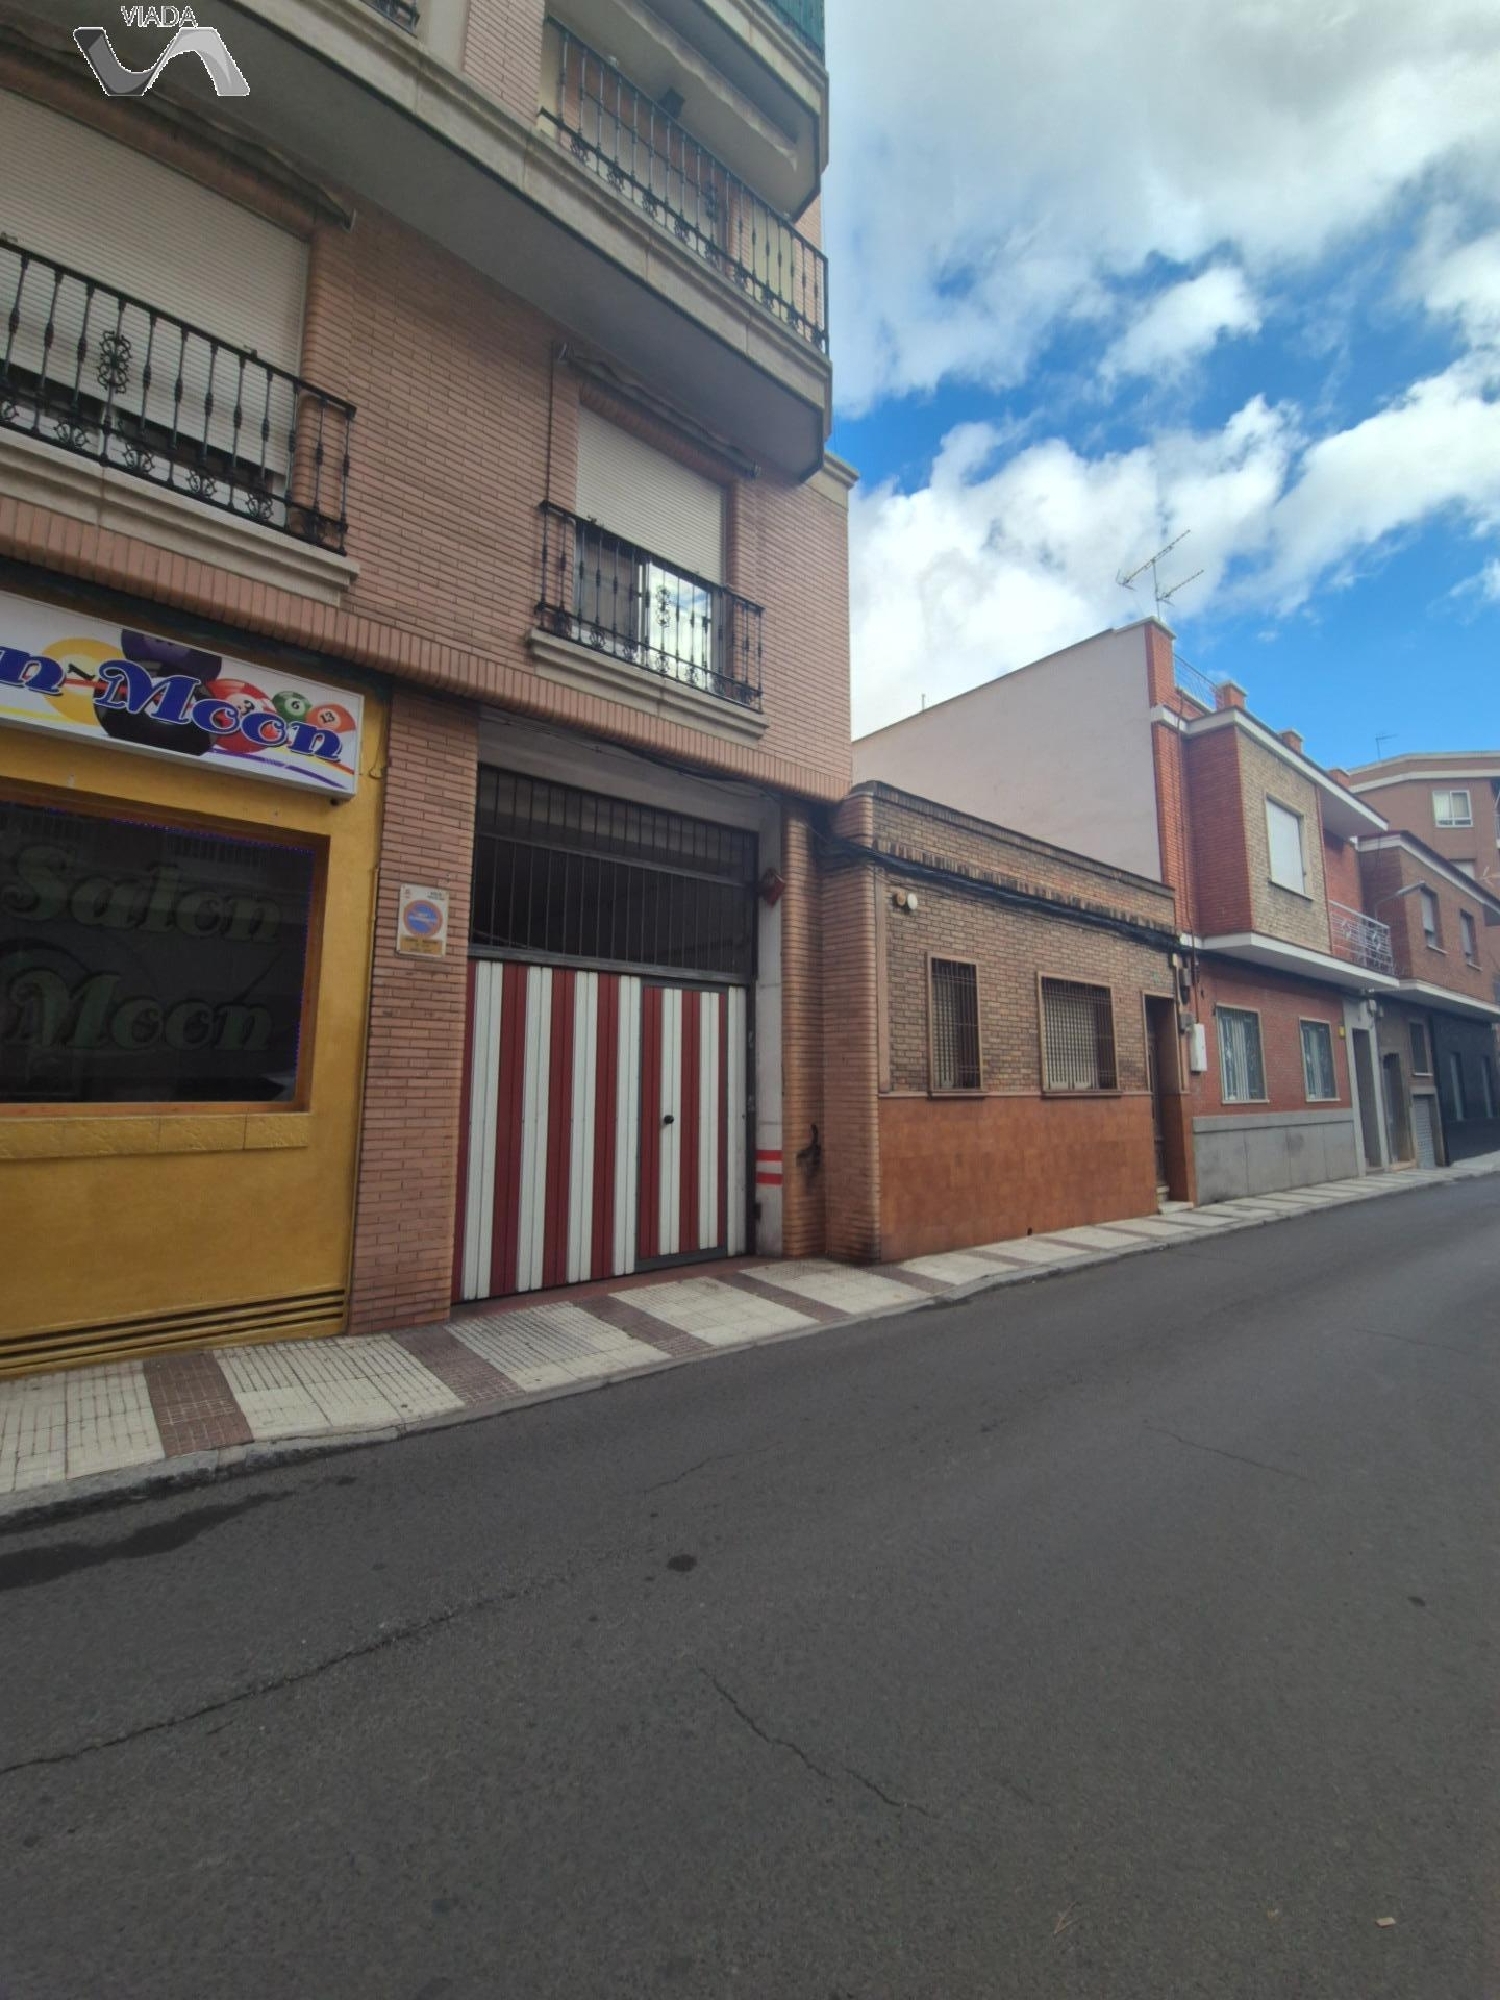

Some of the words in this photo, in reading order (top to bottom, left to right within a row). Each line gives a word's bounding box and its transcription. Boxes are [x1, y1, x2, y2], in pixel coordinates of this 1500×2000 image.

[93, 658, 342, 762] Moon
[319, 710, 336, 724] 13
[1, 844, 282, 944] Salon
[4, 967, 273, 1052] Moon
